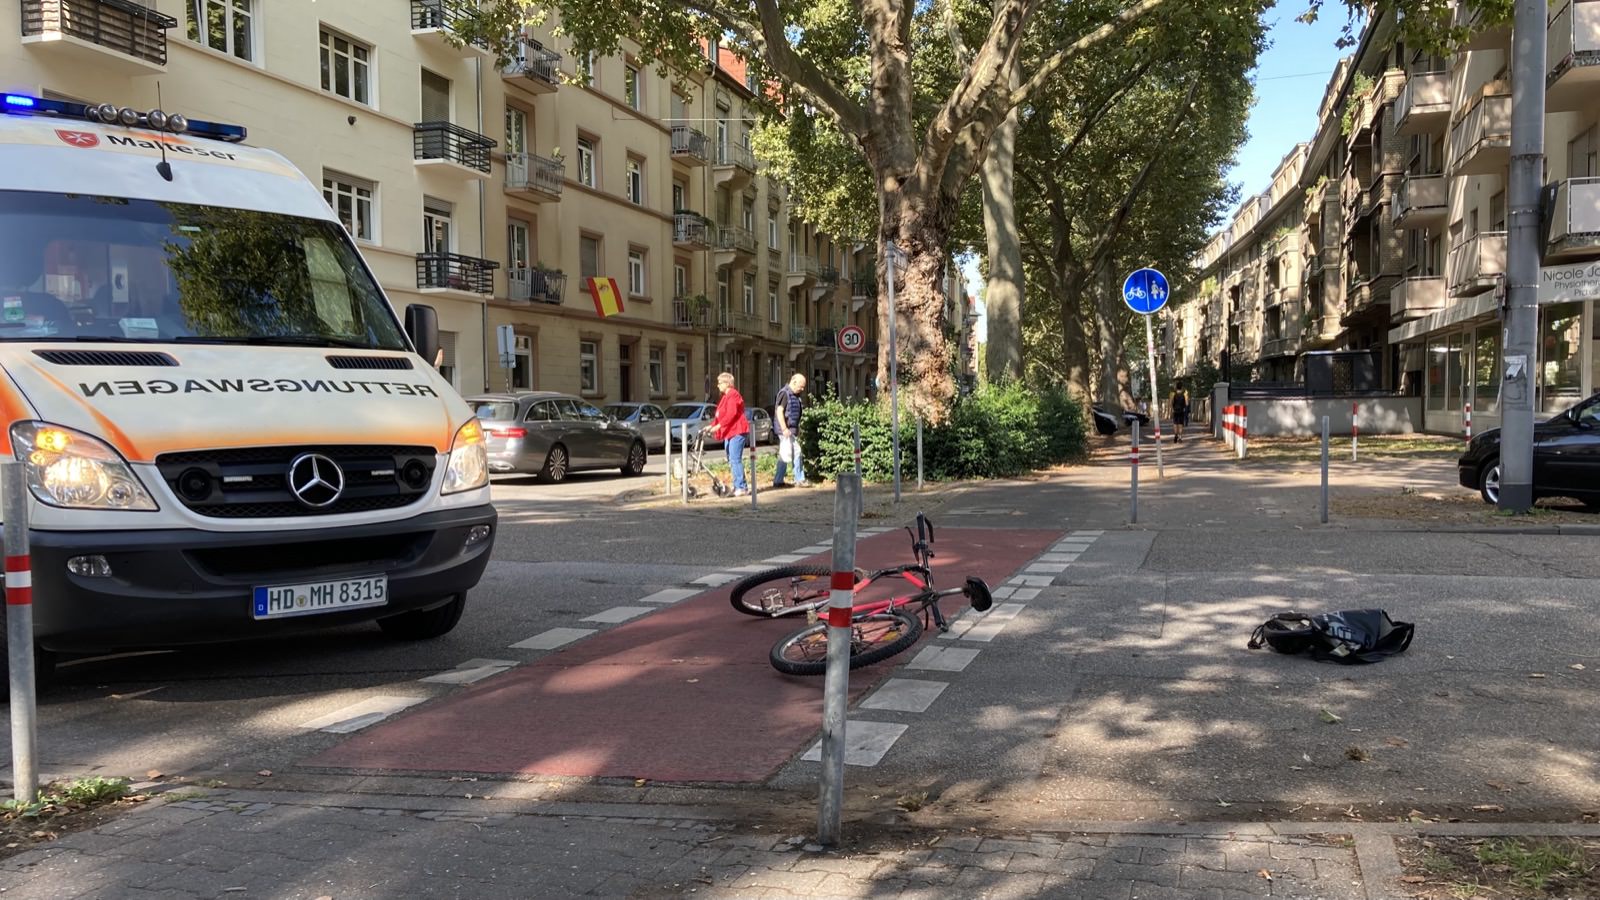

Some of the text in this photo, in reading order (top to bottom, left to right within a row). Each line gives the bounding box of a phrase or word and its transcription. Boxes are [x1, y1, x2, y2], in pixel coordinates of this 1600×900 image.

[106, 135, 236, 161] Malteser
[1543, 268, 1584, 282] Nicole
[1554, 279, 1600, 289] Physiother
[844, 333, 859, 346] 30
[269, 579, 384, 611] HD MH 8315
